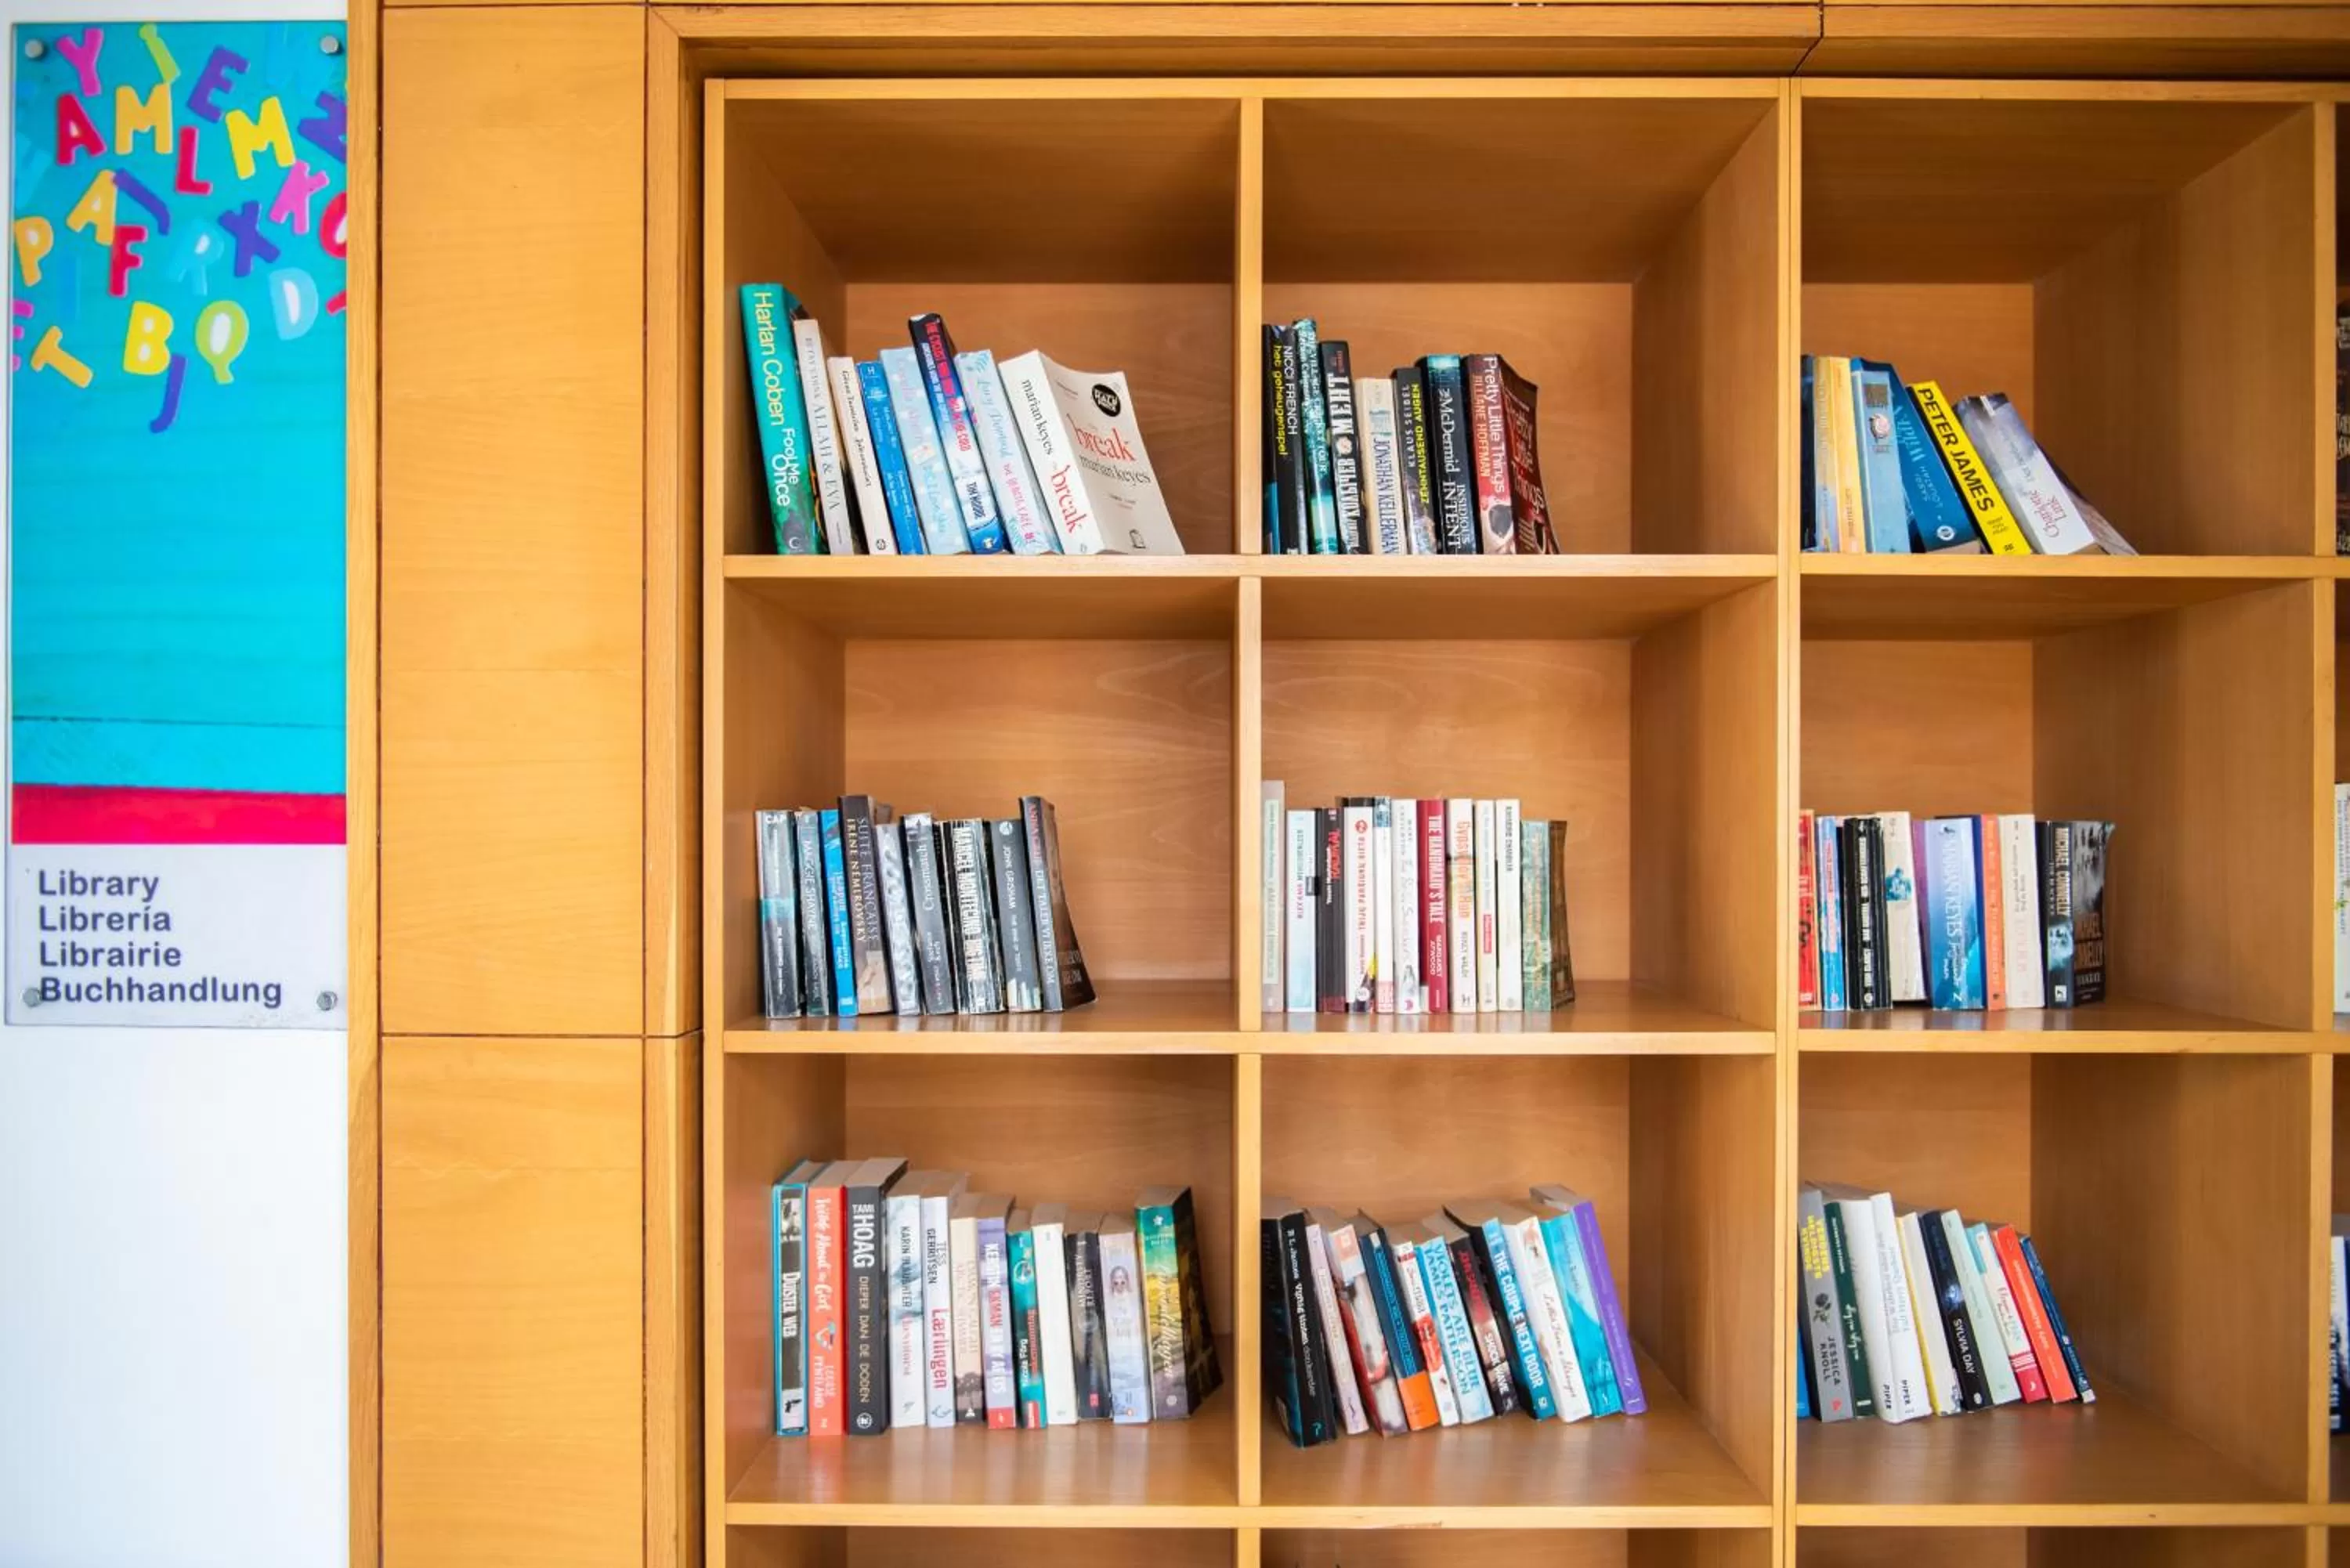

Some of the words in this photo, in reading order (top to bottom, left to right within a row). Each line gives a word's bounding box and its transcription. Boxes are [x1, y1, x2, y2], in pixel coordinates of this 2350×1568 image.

[56, 28, 103, 97] Y
[186, 45, 250, 123] E
[55, 92, 107, 165] A
[115, 83, 172, 155] M
[225, 96, 295, 179] M
[175, 126, 212, 195] L
[66, 169, 117, 246] A
[269, 159, 329, 234] K
[13, 216, 53, 286] P
[108, 226, 147, 297] F
[218, 201, 280, 277] X
[268, 268, 319, 341] D
[753, 291, 776, 356] Harlan
[31, 326, 93, 388] T
[123, 301, 174, 375] B
[195, 301, 249, 384] Q
[1282, 345, 1296, 378] NICCI
[150, 354, 186, 433] J
[762, 359, 786, 426] Coben
[1327, 372, 1355, 435] МЕНТ
[1401, 383, 1412, 426] SEIDEL
[1410, 383, 1423, 423] AUGEN
[1482, 356, 1499, 406] Pretty
[1020, 379, 1044, 422] marian
[1032, 420, 1055, 457] keyes
[1273, 370, 1289, 456] geheugenspel
[1285, 382, 1298, 435] FRENCH
[1488, 405, 1504, 442] Little
[782, 428, 798, 459] Fool
[812, 403, 833, 458] ALLAH
[824, 479, 841, 513] EVA
[1066, 414, 1136, 462] break
[1405, 430, 1415, 468] KLAUS
[1438, 397, 1461, 474] McDermid
[1476, 423, 1491, 478] HOFFMAN
[1918, 387, 1959, 447] PETER
[1950, 449, 1995, 513] JAMES
[771, 453, 791, 508] Once
[787, 461, 801, 486] Me
[1079, 454, 1115, 479] marian
[1112, 464, 1152, 487] keyes
[1372, 436, 1393, 492] JONATHAN
[1415, 425, 1430, 504] ZEHNTAUSEND
[1490, 443, 1506, 494] Things
[1050, 464, 1087, 534] break
[1441, 480, 1462, 550] INTENT
[1455, 484, 1471, 545] INSIDIOUS
[1376, 493, 1400, 555] KELLERMAN
[858, 818, 871, 856] SUITE
[1427, 814, 1443, 834] THE
[1454, 821, 1471, 857] Gypsy
[2054, 826, 2070, 866] MICHAEL
[802, 840, 815, 887] MAGGIE
[953, 826, 974, 871] MARCEL
[1001, 844, 1013, 869] JOHN
[1428, 835, 1443, 901] HANDMAID'S
[38, 869, 159, 902] Library
[956, 872, 982, 935] MONTECINO
[1004, 869, 1017, 909] GRISHAM
[2055, 869, 2071, 916] CONNELLY
[38, 905, 172, 931] Librería
[805, 889, 818, 930] SHAYNE
[1428, 902, 1443, 925] TALE
[1943, 894, 1963, 938] KEYES
[39, 941, 182, 967] Librairie
[40, 977, 282, 1009] Buchhandlung
[851, 1204, 875, 1214] TAMI
[815, 1233, 833, 1269] About
[851, 1213, 876, 1270] HOAG
[901, 1225, 912, 1254] KARIN
[927, 1227, 938, 1284] GERRITSEN
[935, 1240, 947, 1266] TESS
[1494, 1250, 1509, 1276] THE
[902, 1255, 913, 1307] SLAUGHTER
[985, 1242, 1001, 1287] KERSTIN
[1434, 1242, 1459, 1310] VIOLETS
[782, 1270, 801, 1313] DUISTER
[814, 1282, 833, 1312] Girl
[858, 1276, 870, 1311] DIEPER
[989, 1288, 1004, 1328] EKMAN
[1289, 1247, 1300, 1279] James
[1298, 1313, 1309, 1345] tinten
[1501, 1274, 1523, 1321] COUPLE
[782, 1316, 800, 1338] WEB
[859, 1315, 870, 1339] DAN
[1424, 1247, 1448, 1300] JAMES
[1439, 1303, 1471, 1395] PATTERSON
[1450, 1312, 1470, 1347] ARE
[1512, 1321, 1530, 1354] NEXT
[1952, 1317, 1972, 1353] SYLVIA
[859, 1343, 869, 1357] DE
[928, 1307, 951, 1389] Lærlingen
[1459, 1350, 1481, 1389] BLUE
[1484, 1332, 1499, 1365] SHOCK
[1820, 1342, 1831, 1383] KNOLL
[1826, 1335, 1842, 1386] JESSICA
[1961, 1353, 1977, 1375] DAY
[859, 1363, 871, 1404] DODEN
[1490, 1364, 1509, 1394] WAVE
[1521, 1355, 1546, 1389] DOOR
[1901, 1378, 1912, 1407] PIPER
[1882, 1384, 1893, 1411] PIPER
